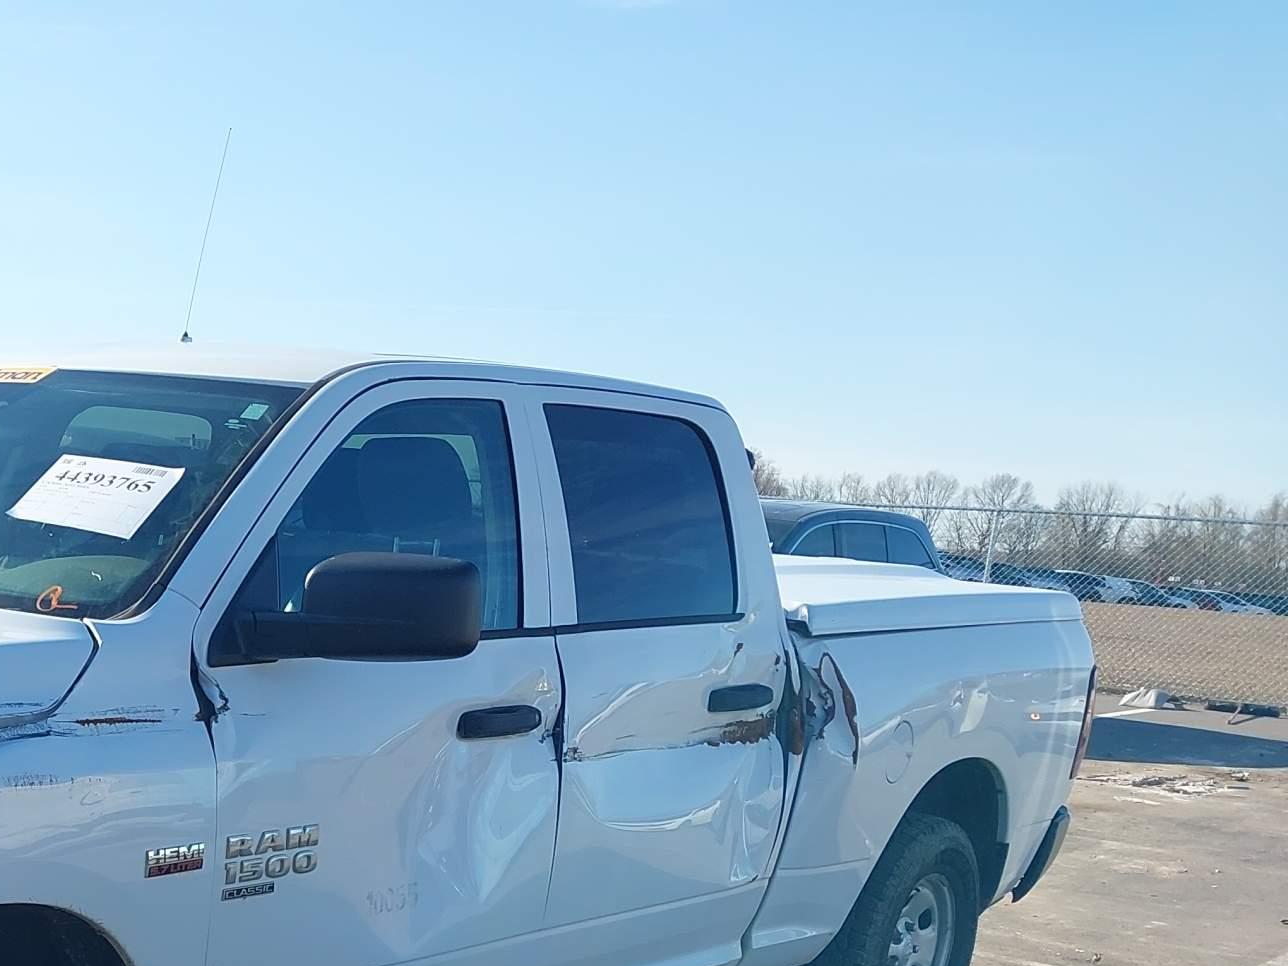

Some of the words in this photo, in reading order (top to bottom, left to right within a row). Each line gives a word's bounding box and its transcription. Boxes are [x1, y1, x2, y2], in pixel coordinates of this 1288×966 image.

[55, 470, 156, 493] 44393765
[225, 824, 319, 859] RAM
[147, 843, 205, 864] HEMI
[170, 861, 201, 872] LITER
[224, 850, 318, 884] 1500
[225, 883, 273, 899] CLASSIC
